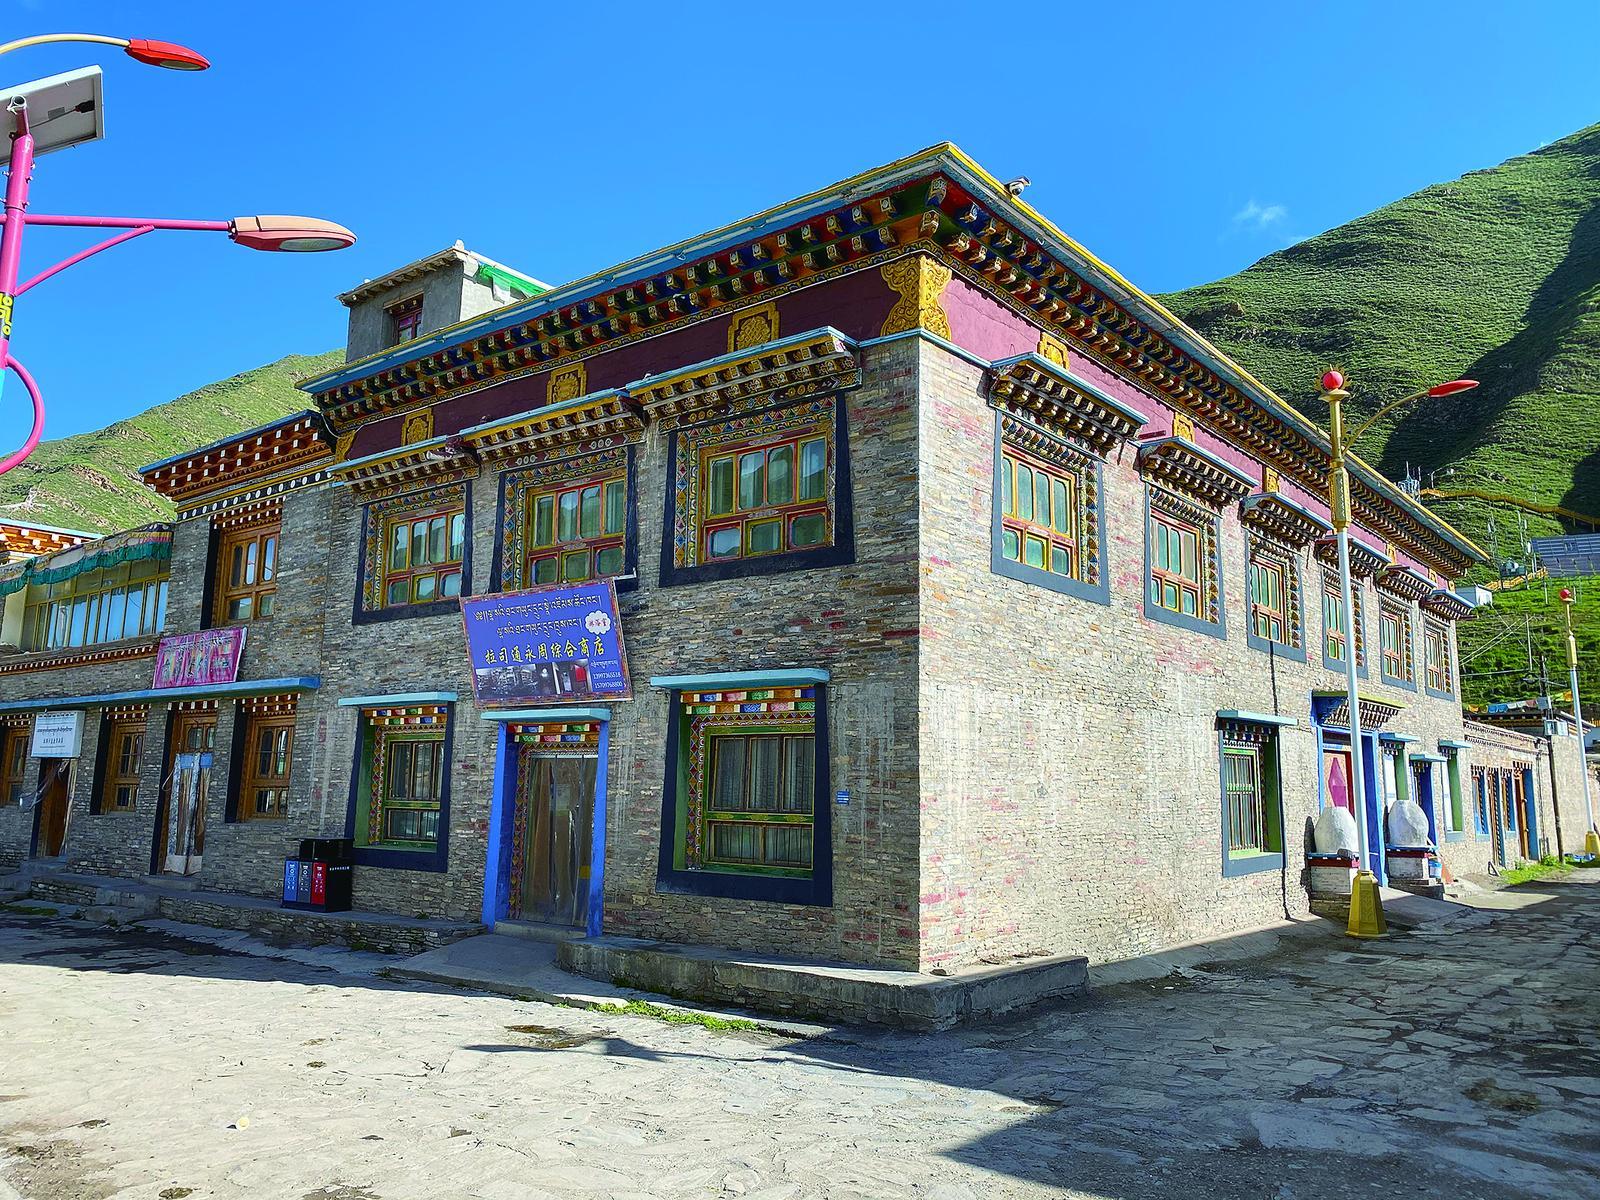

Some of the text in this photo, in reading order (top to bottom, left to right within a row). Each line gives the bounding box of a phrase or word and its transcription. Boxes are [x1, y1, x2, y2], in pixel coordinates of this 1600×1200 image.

[485, 636, 604, 664] 拉司通永周综合商店
